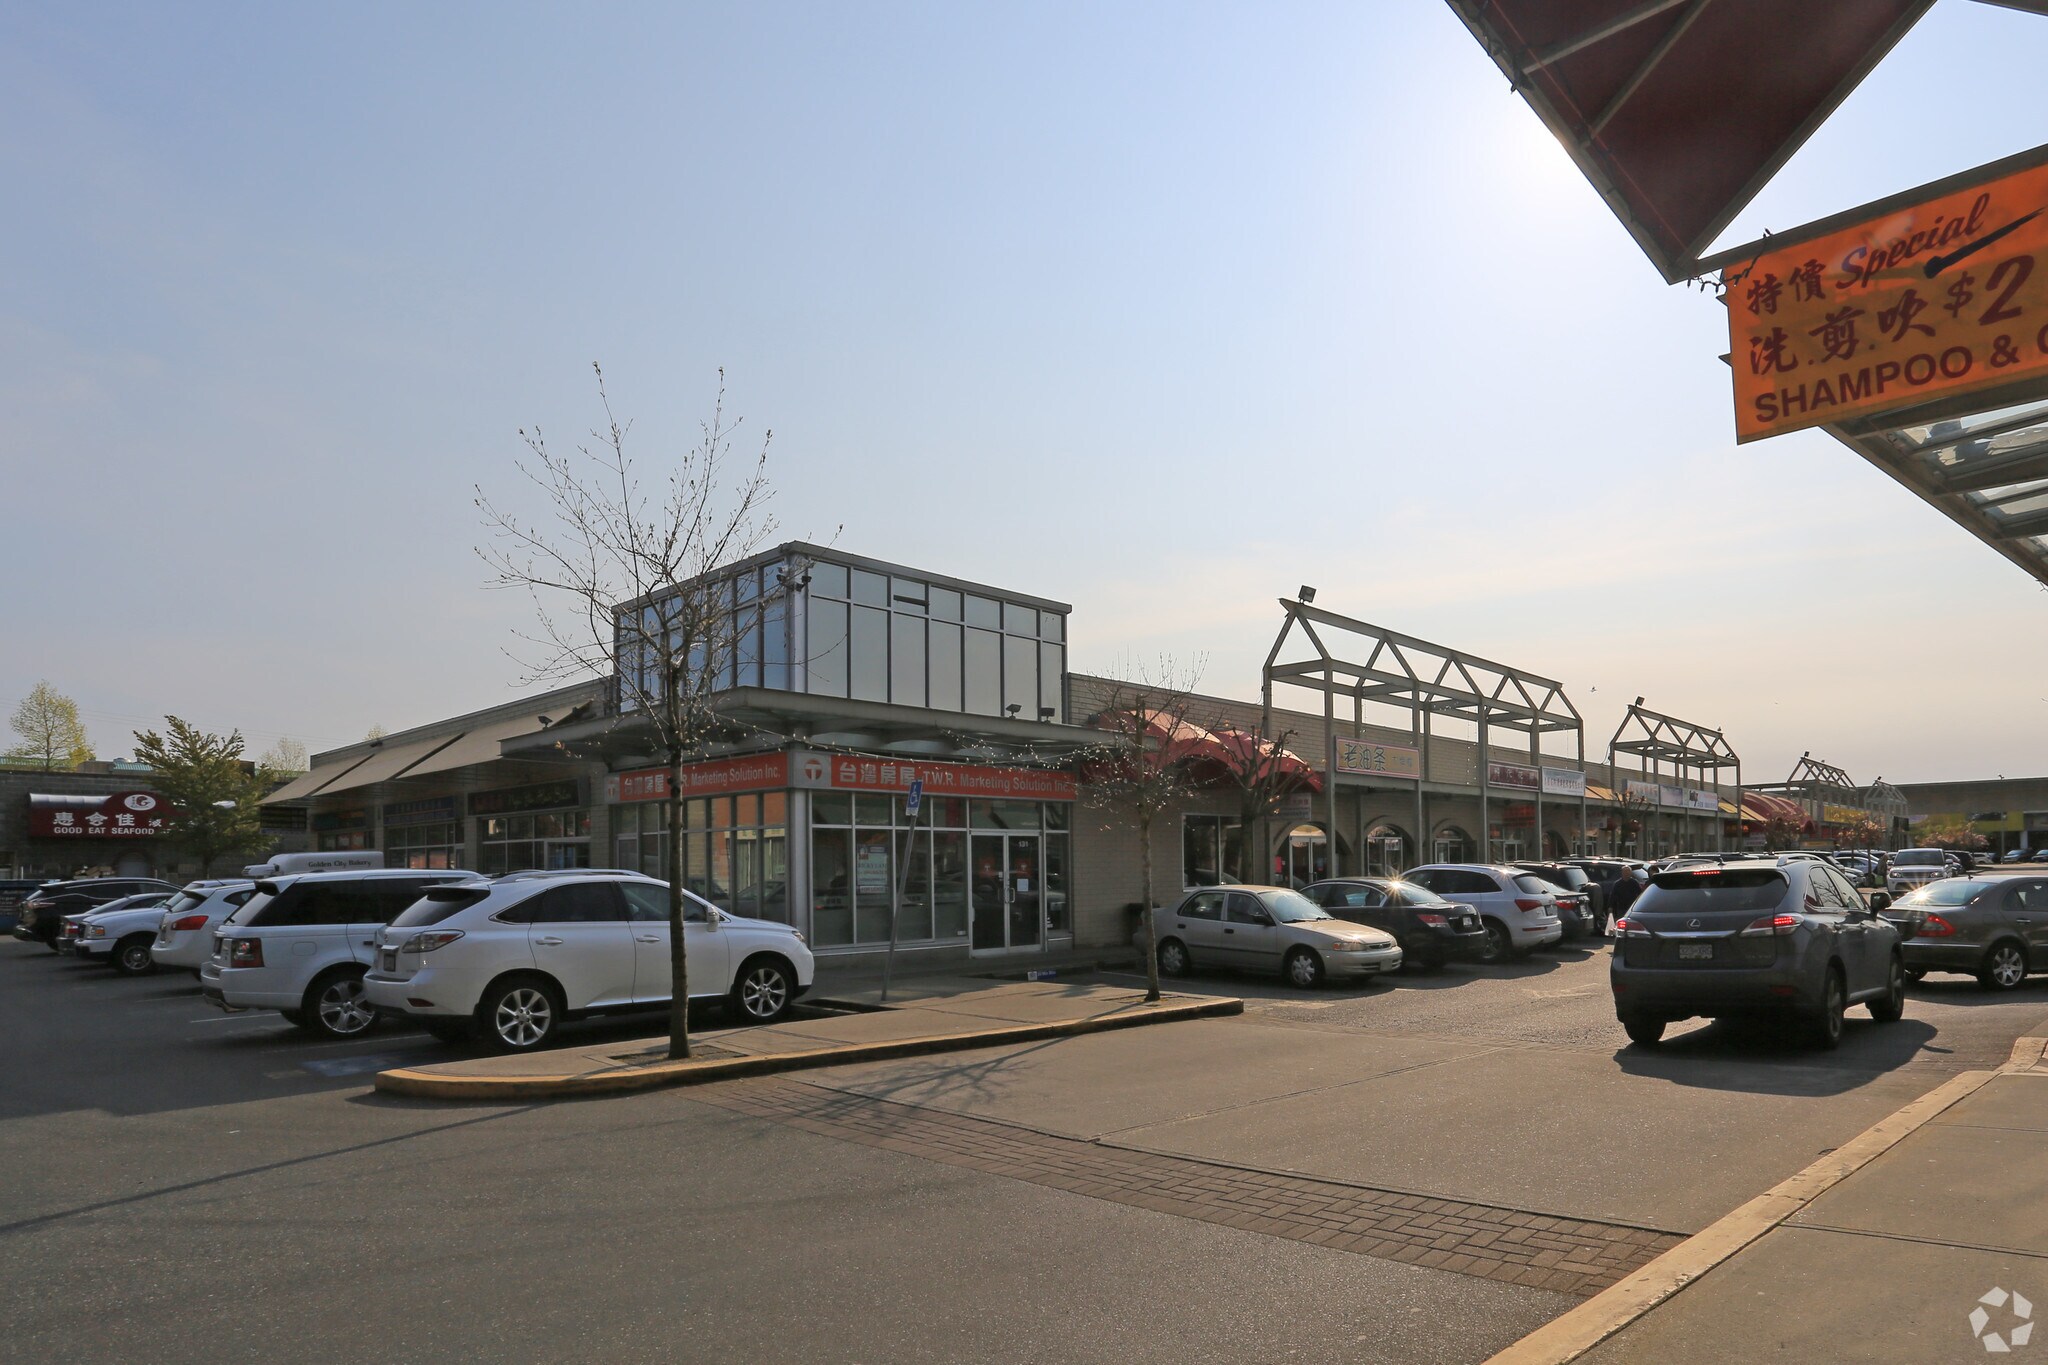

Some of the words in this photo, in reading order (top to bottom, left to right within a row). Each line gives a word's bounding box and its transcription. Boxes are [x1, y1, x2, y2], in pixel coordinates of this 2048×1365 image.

[1746, 258, 1827, 316] 特價
[1836, 192, 1991, 289] Special
[1754, 346, 1973, 423] SHAMPOO
[1989, 334, 2020, 369] &
[691, 771, 728, 787] Marketing
[729, 765, 764, 783] Solution
[765, 763, 781, 778] Inc.
[922, 770, 957, 786] T.W.R.
[960, 774, 1010, 793] Marketing
[1012, 776, 1053, 792] Solution
[53, 826, 83, 834] GOOD
[88, 826, 107, 834] EAT
[111, 827, 155, 835] SEAFOOD
[308, 860, 332, 868] Golden
[333, 860, 347, 868] City
[348, 859, 372, 867] Bakery
